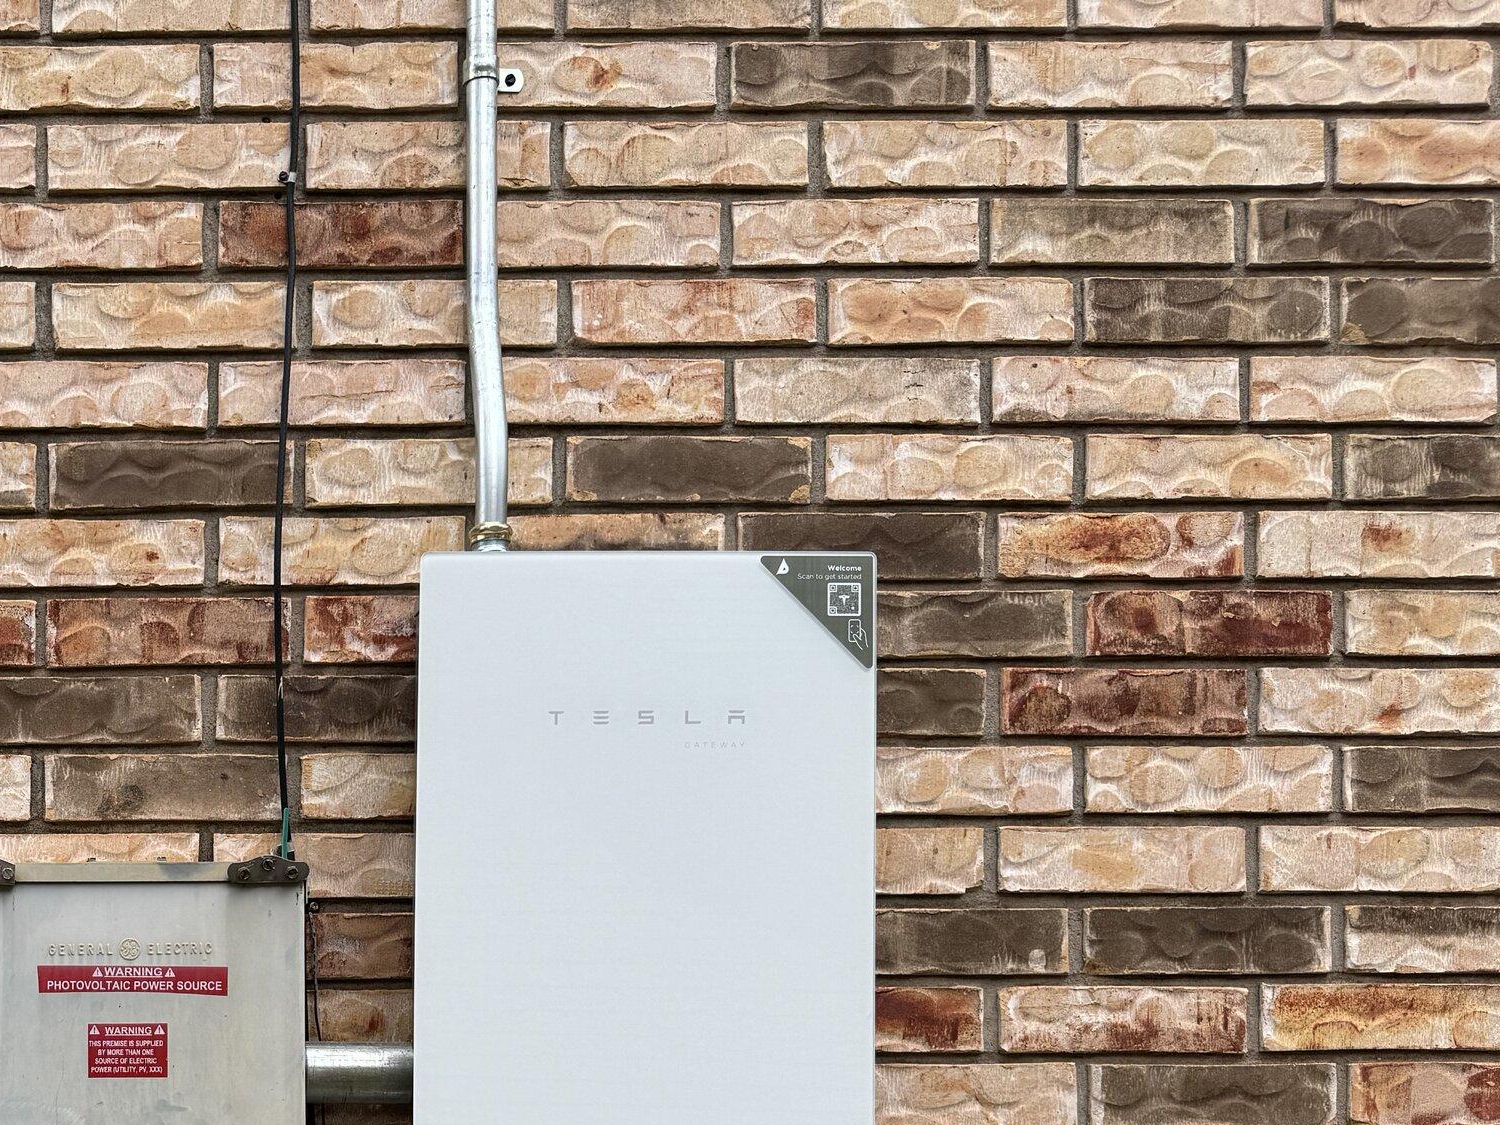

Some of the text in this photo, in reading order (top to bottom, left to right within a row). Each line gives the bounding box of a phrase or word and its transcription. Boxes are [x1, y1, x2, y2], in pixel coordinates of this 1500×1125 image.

[548, 710, 746, 725] TESLA
[684, 741, 746, 749] GATEWAY
[48, 943, 113, 957] GENERAL
[147, 942, 213, 957] ELECTRIC
[104, 967, 163, 977] WARNING
[46, 980, 223, 992] PHOTOVOLTAIC POWER SOURCE
[104, 1026, 152, 1036] WARNING
[90, 1066, 112, 1074] POWER
